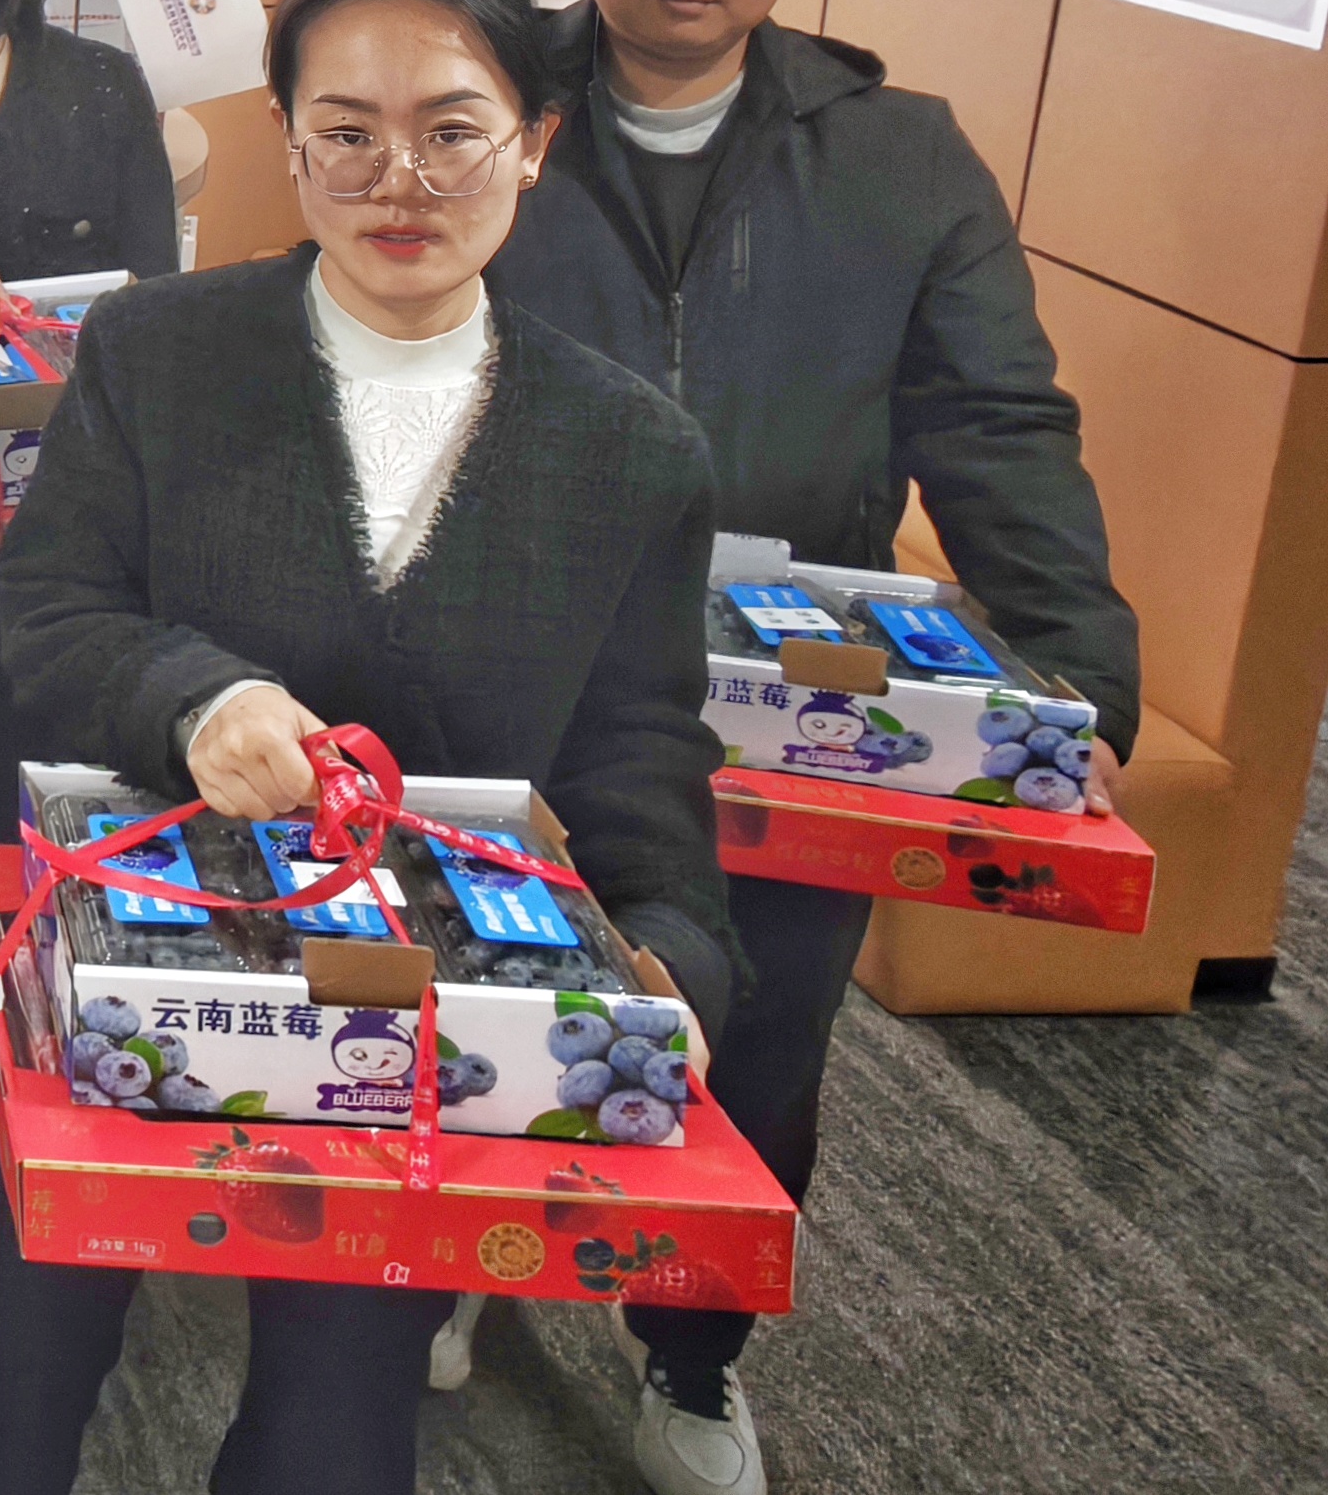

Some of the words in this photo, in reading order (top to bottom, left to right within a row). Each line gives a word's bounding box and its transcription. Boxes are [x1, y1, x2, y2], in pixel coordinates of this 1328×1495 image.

[709, 677, 793, 710] 蓝莓
[151, 997, 324, 1041] 云南蓝莓
[333, 1092, 414, 1108] BLUEBERR
